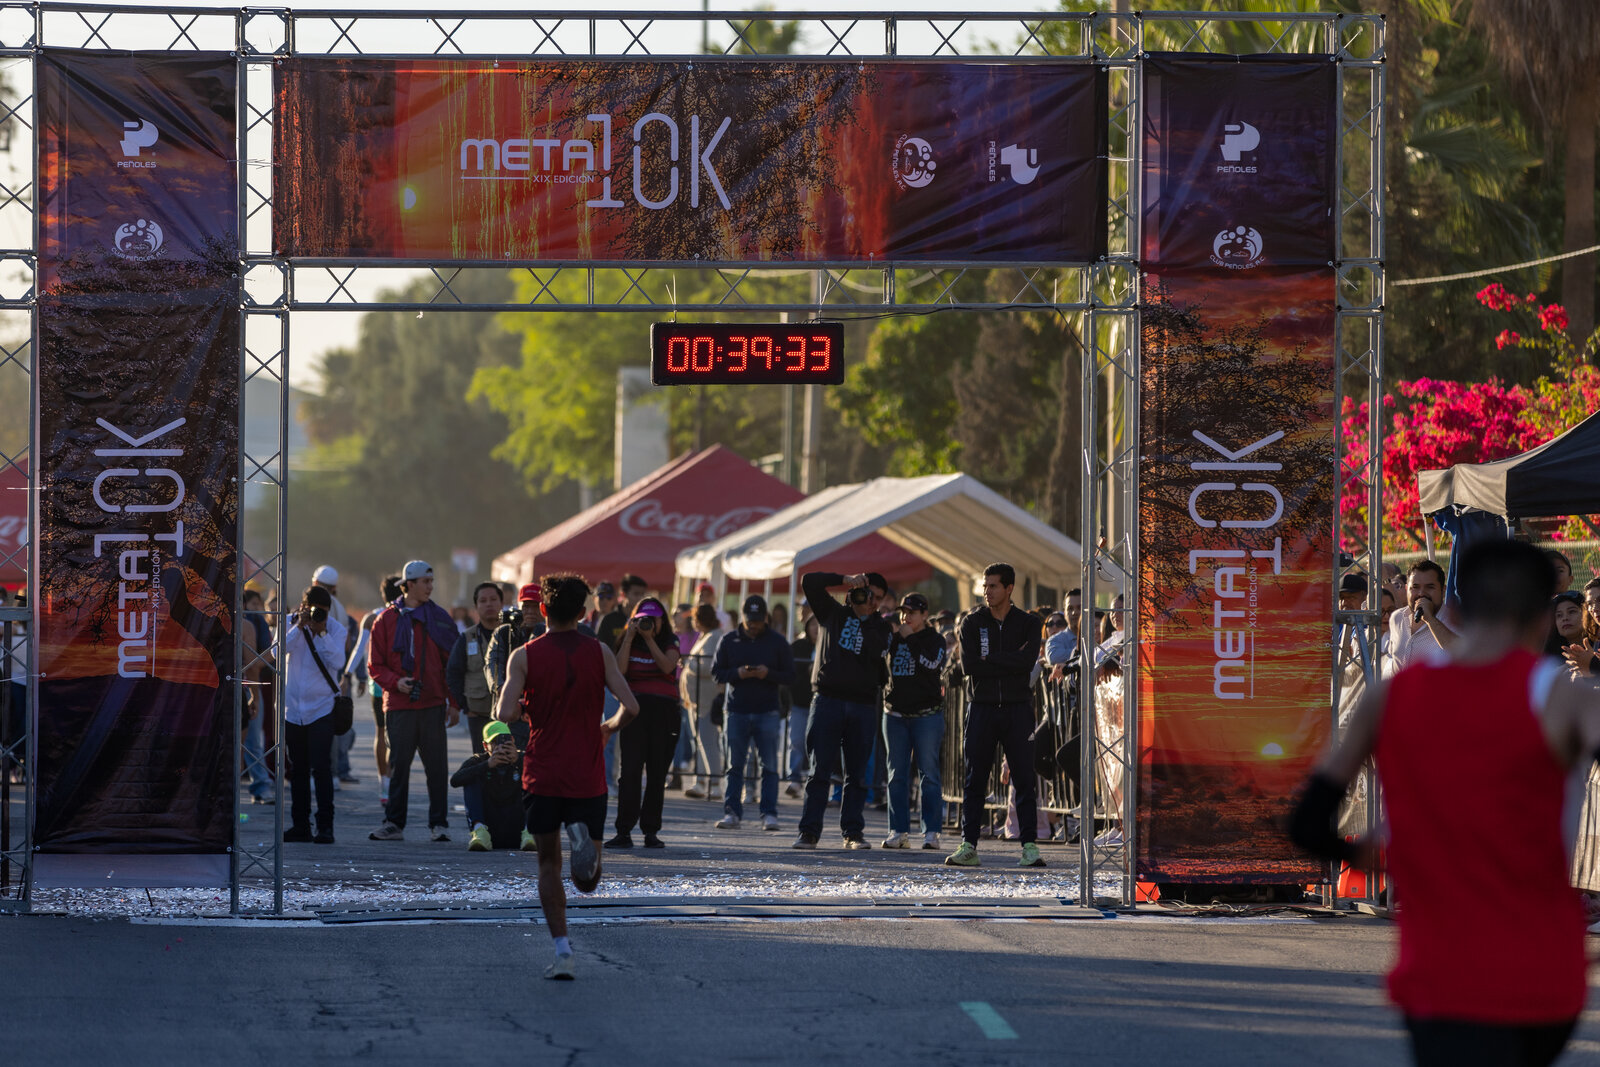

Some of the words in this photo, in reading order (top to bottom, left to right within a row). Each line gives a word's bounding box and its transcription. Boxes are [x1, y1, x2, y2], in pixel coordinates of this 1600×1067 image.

[460, 138, 594, 170] META
[586, 112, 732, 210] 10K
[533, 174, 551, 183] XIX
[667, 336, 831, 372] 00:39:33
[92, 417, 187, 558] 10K
[1188, 429, 1285, 576] 10K
[117, 550, 149, 678] META
[151, 591, 160, 609] XIX
[1213, 567, 1246, 700] META
[1248, 610, 1257, 628] XIX
